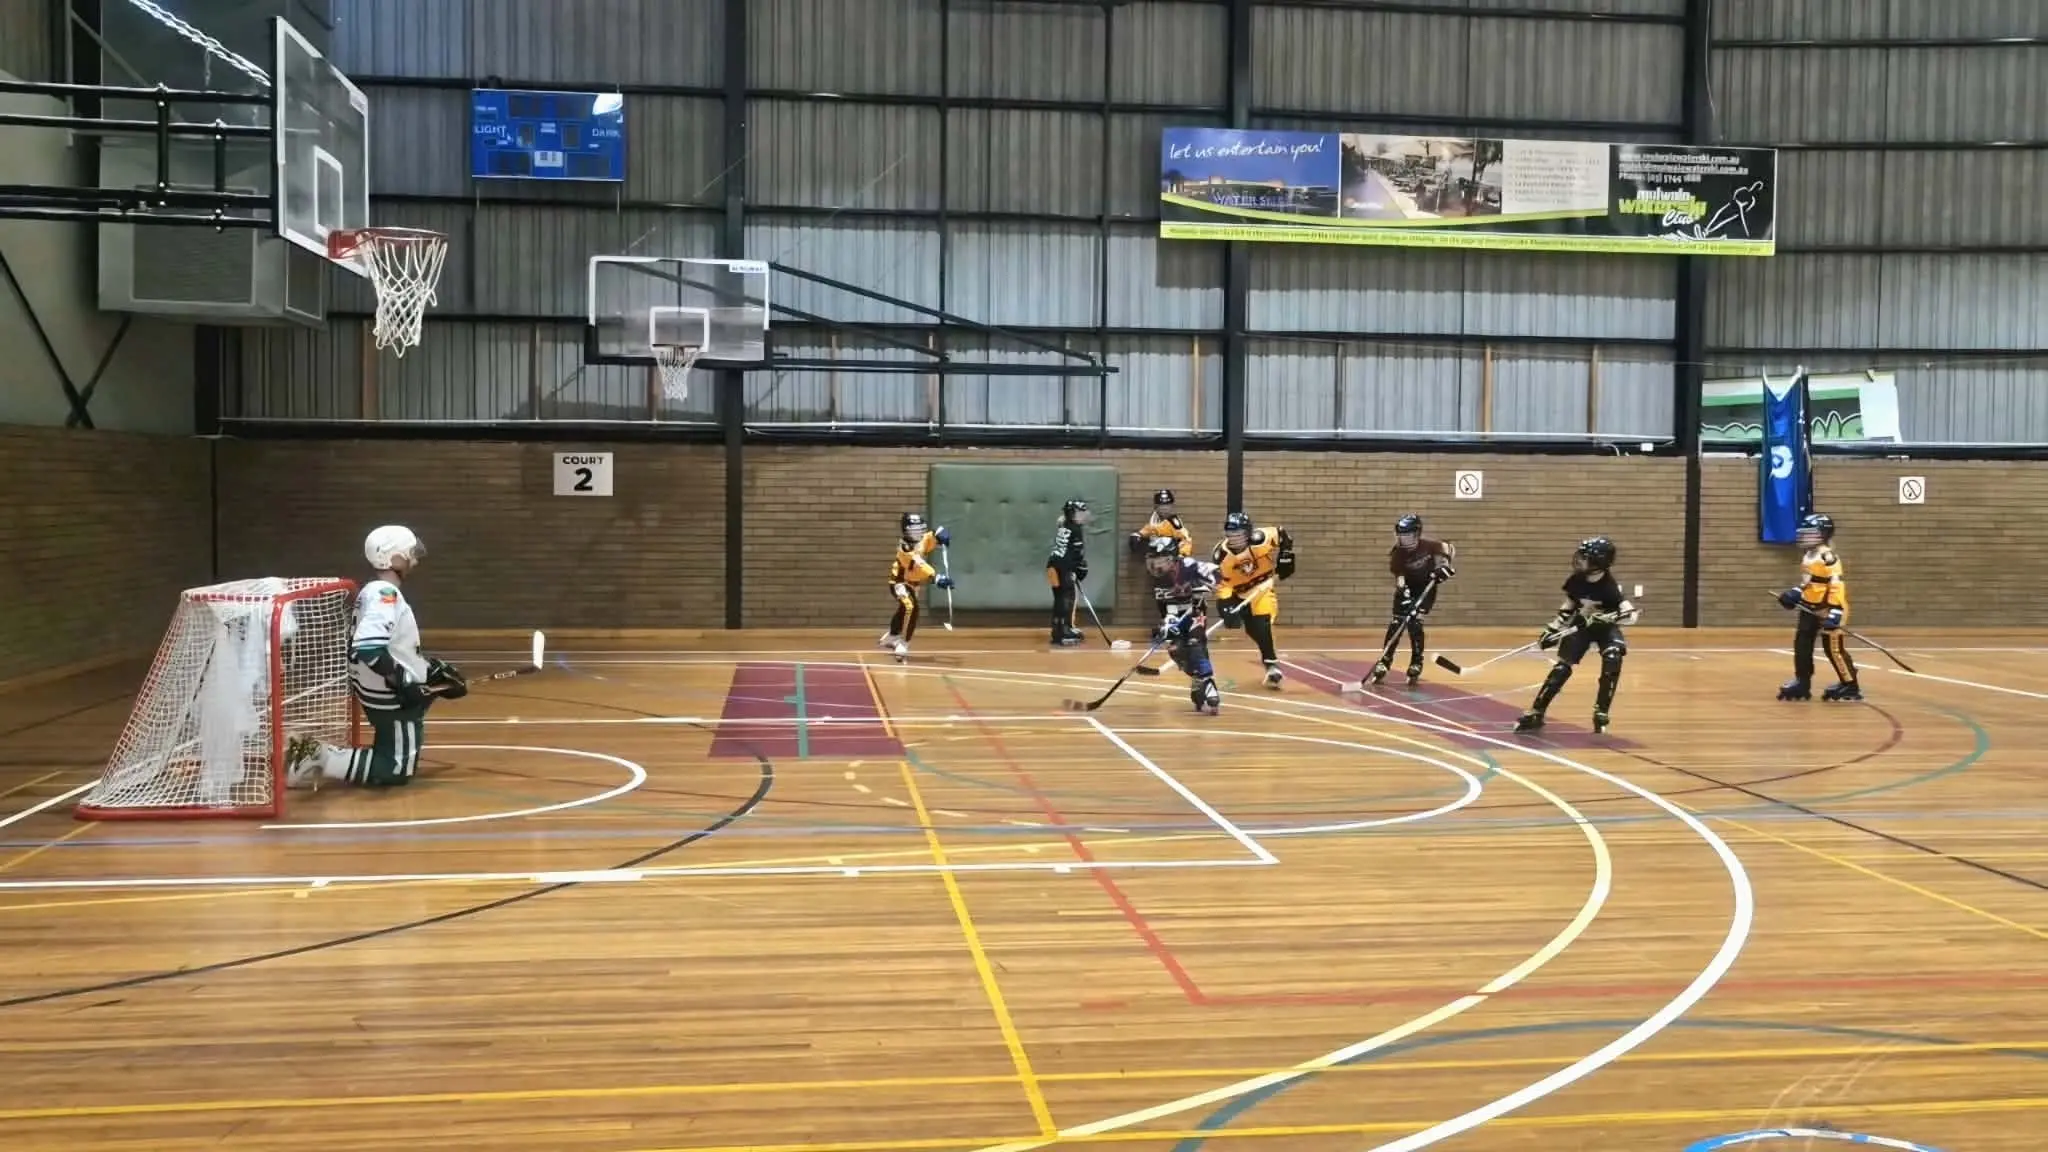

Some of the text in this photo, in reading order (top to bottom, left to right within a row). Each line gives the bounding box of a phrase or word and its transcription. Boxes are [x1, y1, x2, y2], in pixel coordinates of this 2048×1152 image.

[1169, 143, 1191, 160] let
[562, 456, 604, 465] COURT
[574, 467, 593, 491] 2
